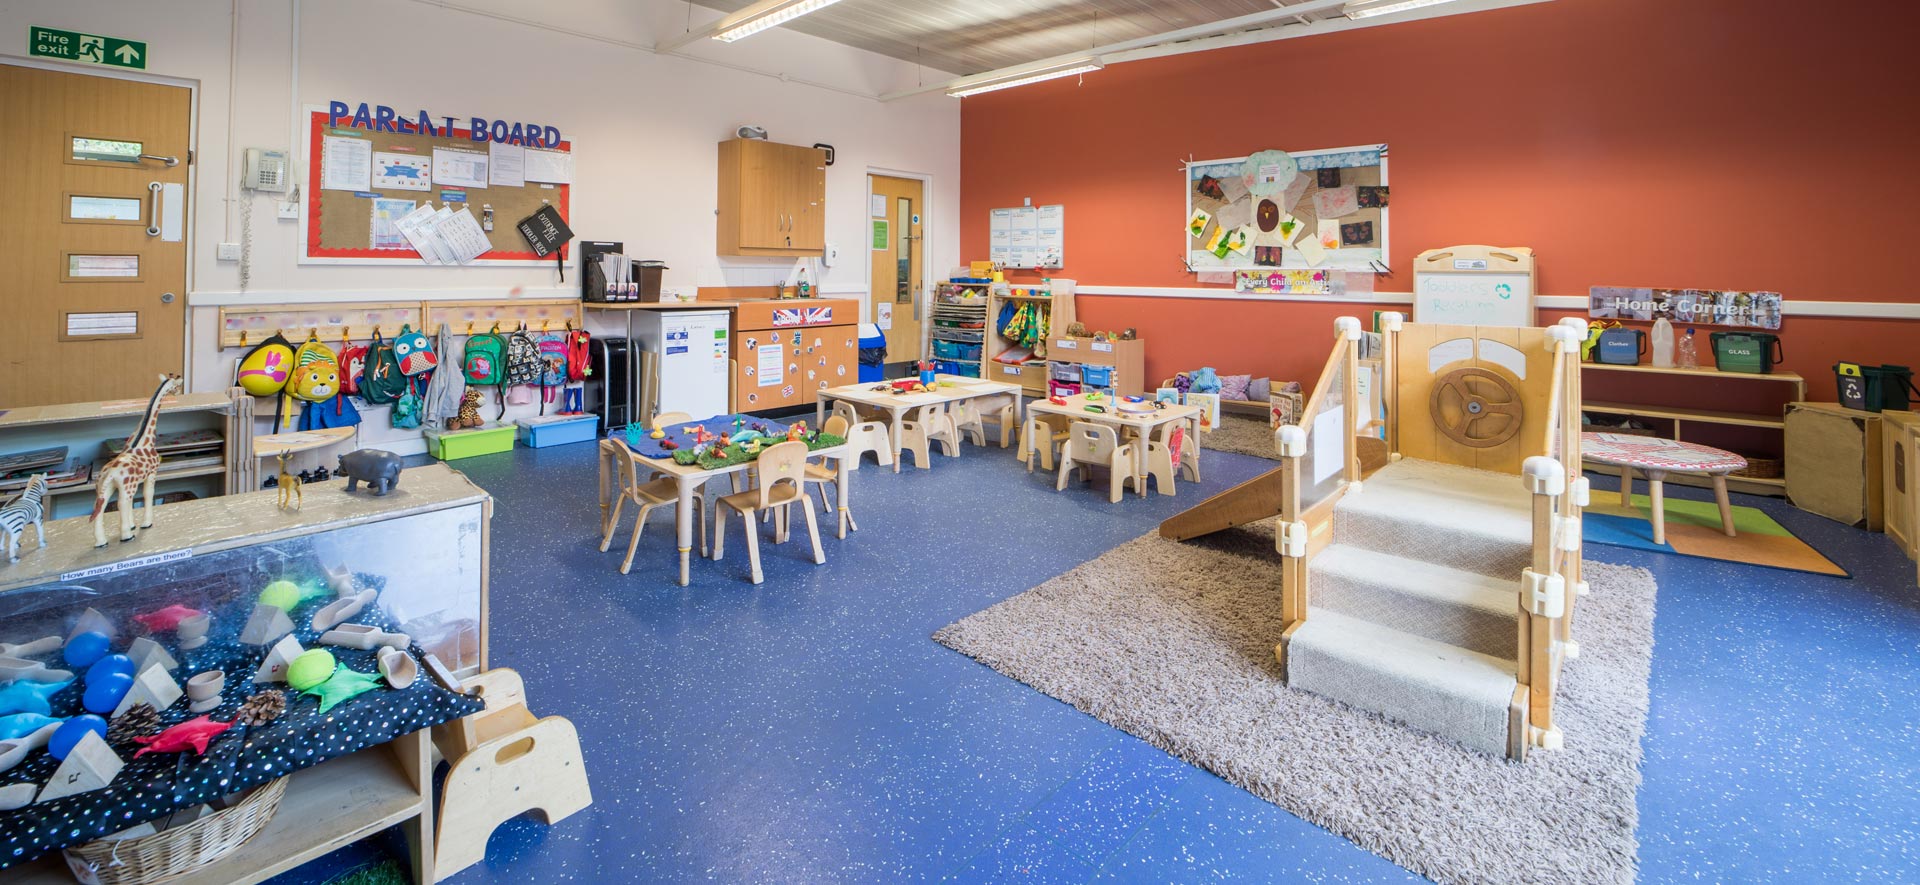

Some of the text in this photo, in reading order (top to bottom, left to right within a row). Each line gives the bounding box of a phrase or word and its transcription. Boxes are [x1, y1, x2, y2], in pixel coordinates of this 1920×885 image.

[37, 31, 69, 44] Fire
[37, 44, 69, 55] exit
[329, 100, 561, 149] PARENT BOARD
[538, 213, 559, 234] EVIDENCE
[542, 229, 556, 243] FILE
[535, 241, 549, 256] ROOM
[1246, 279, 1267, 288] Every
[1271, 278, 1292, 286] Child
[1615, 297, 1749, 316] Home Corner
[62, 571, 85, 581] How
[87, 566, 114, 576] many
[116, 560, 144, 570] Bears
[163, 549, 192, 561] there?
